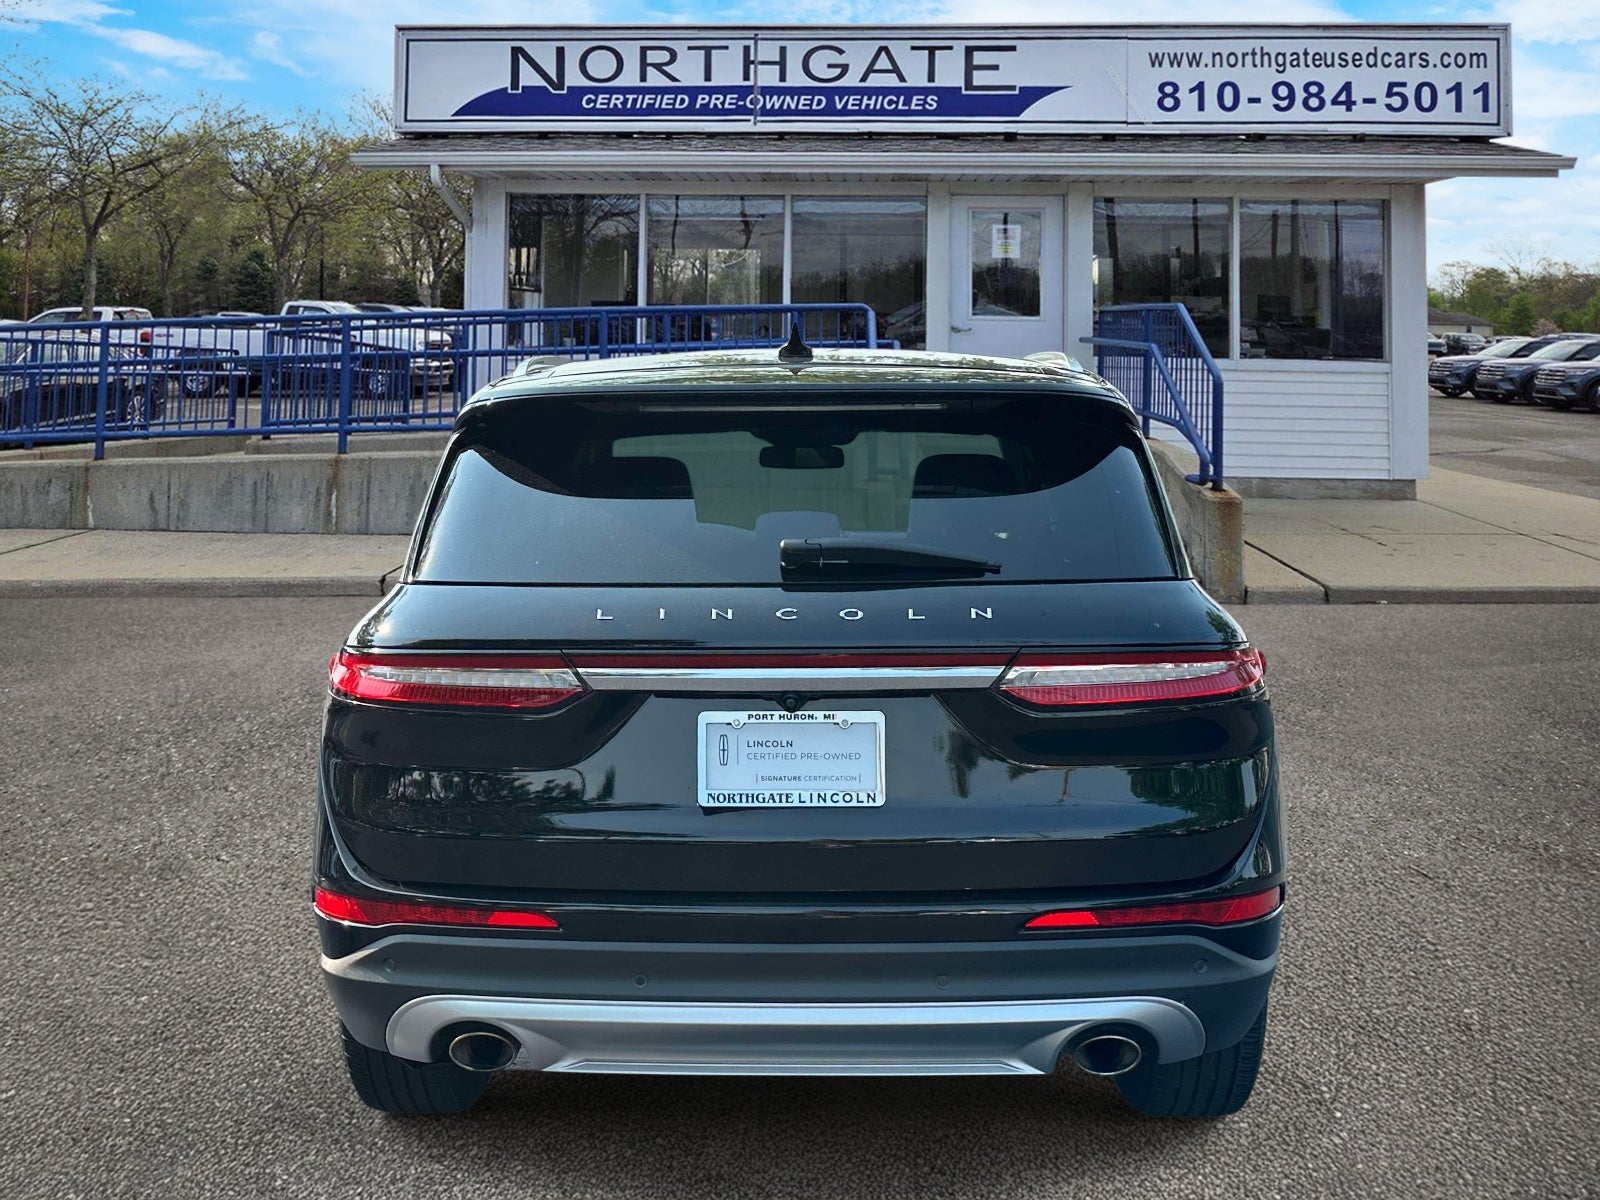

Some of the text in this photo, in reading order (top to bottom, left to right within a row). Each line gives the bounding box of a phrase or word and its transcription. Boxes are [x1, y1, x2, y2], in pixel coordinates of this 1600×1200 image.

[1148, 45, 1489, 73] www.northgateusedcars.com
[509, 44, 1018, 93] NORTHGATE
[581, 93, 938, 112] CERTIFIED PRE-OWNED VEHICLES
[1156, 80, 1491, 113] 810-984-5011
[596, 607, 993, 621] LINCOLN
[747, 713, 775, 721] PORT
[823, 713, 836, 721] MI
[746, 740, 793, 748] LINCOLN
[746, 752, 862, 760] CERTIFIED PRE-OWNED
[706, 792, 877, 804] NORTHGATE LINCOLN
